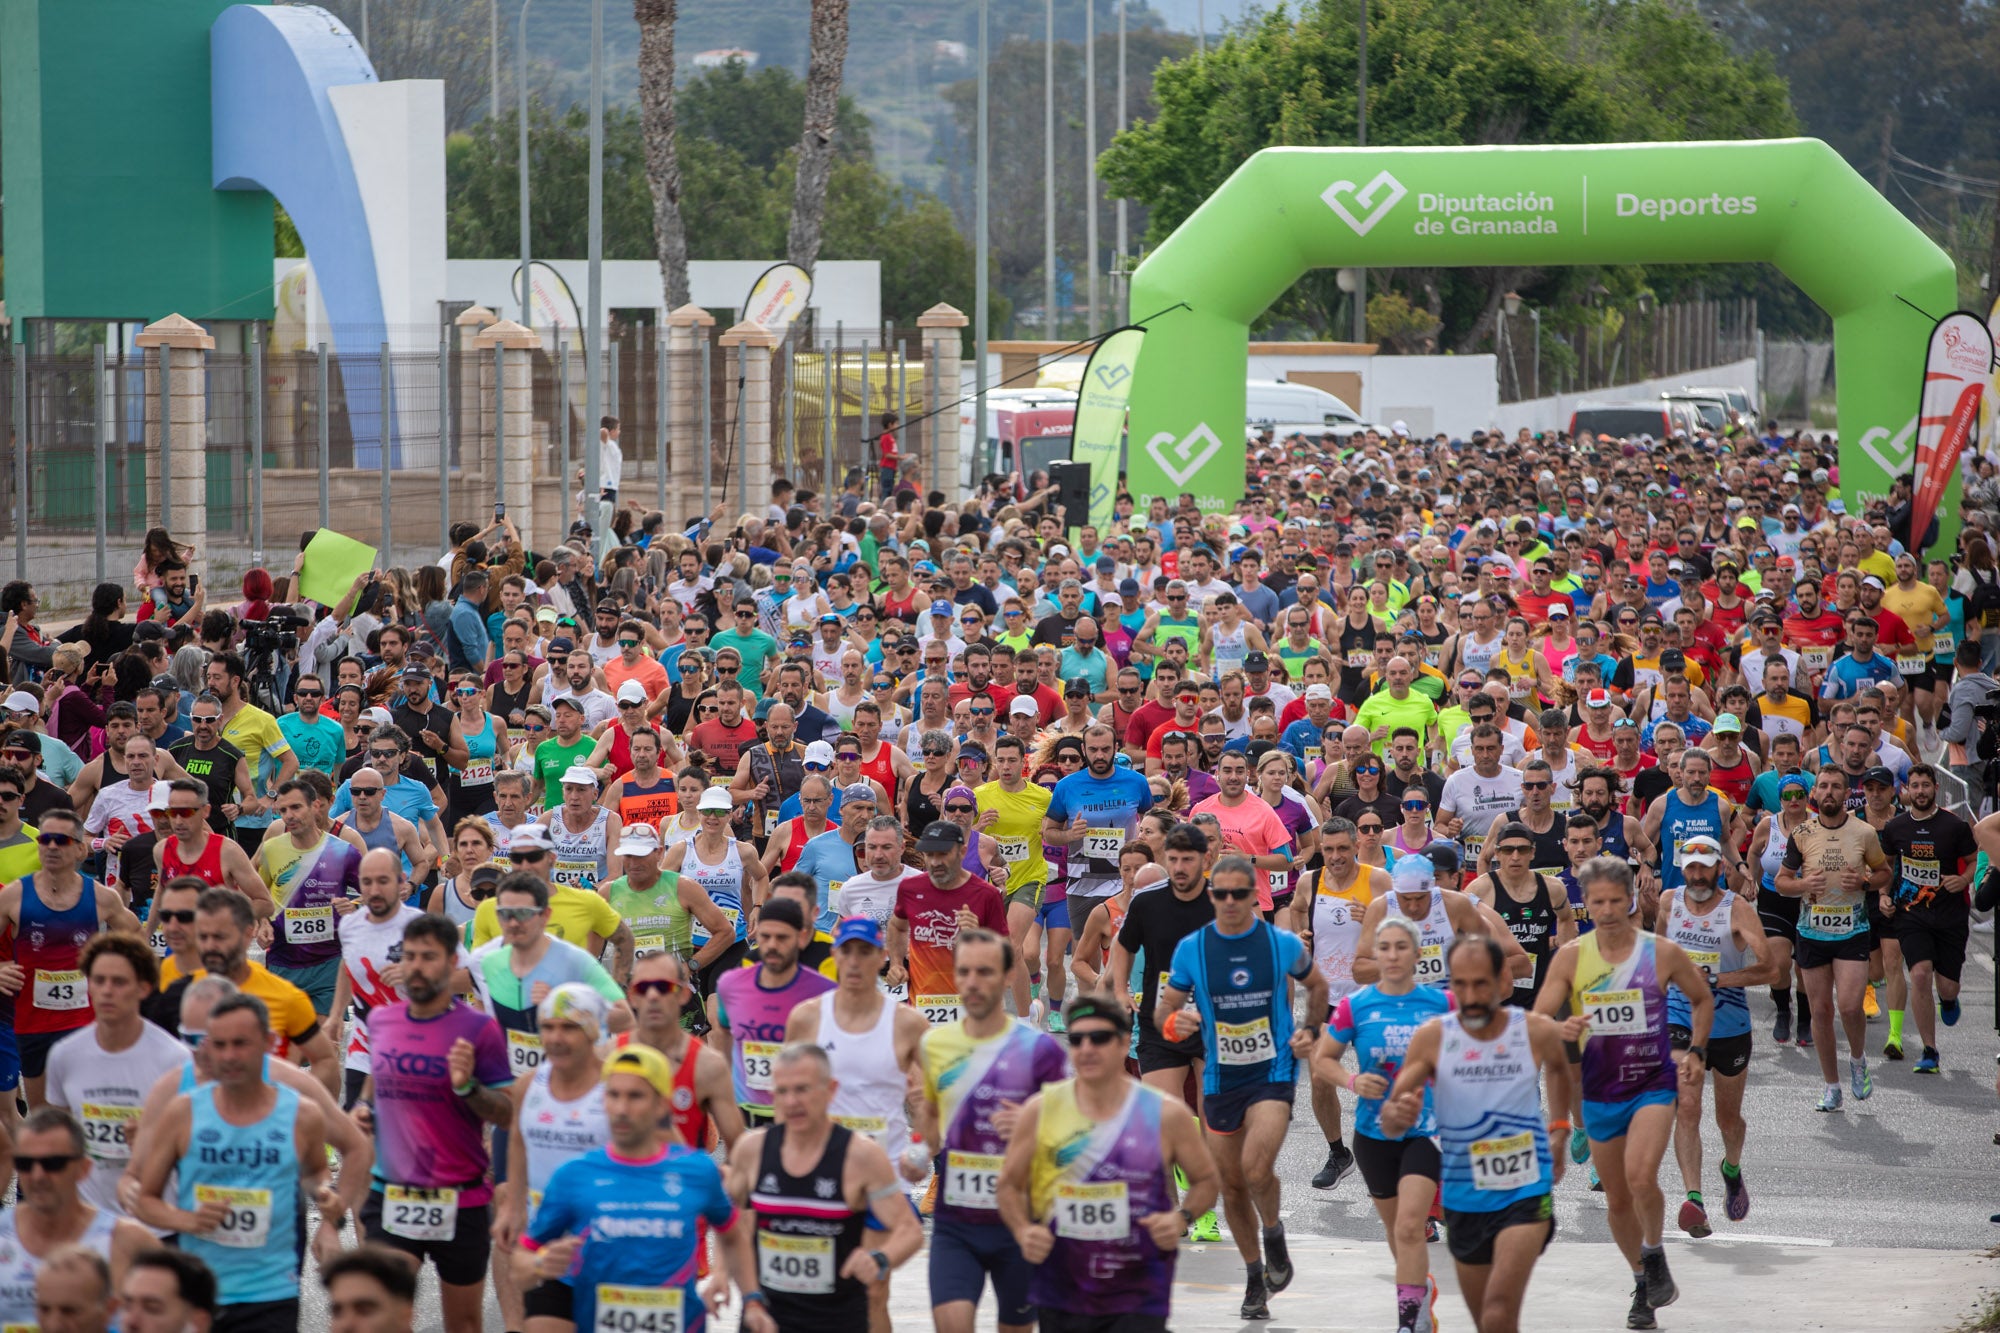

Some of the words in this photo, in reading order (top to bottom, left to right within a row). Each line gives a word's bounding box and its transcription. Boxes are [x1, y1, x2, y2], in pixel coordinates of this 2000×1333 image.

[1417, 190, 1556, 217] Diputación
[1615, 192, 1758, 221] Deportes
[1413, 216, 1445, 236] de
[1450, 213, 1559, 236] Granada
[1939, 392, 1978, 471] saborgranada.es
[1140, 494, 1224, 509] Diutción
[1809, 654, 1823, 664] 39
[1899, 661, 1924, 670] 3178
[186, 761, 213, 776] RUN
[461, 766, 492, 779] 2122
[1089, 838, 1118, 852] 732
[1910, 843, 1935, 851] FONDO
[1910, 849, 1935, 858] 2025
[1818, 859, 1848, 868] Maratón
[1903, 864, 1938, 880] 1026
[292, 918, 326, 934] 268
[1812, 914, 1852, 927] 1024
[1413, 958, 1443, 976] 30
[47, 985, 74, 1000] 43
[924, 1008, 959, 1023] 221
[1593, 1004, 1635, 1023] 109
[1219, 1032, 1272, 1055] 3093
[1453, 1063, 1523, 1078] MARACENA
[84, 1121, 128, 1144] 328
[198, 1144, 281, 1169] nerja
[1475, 1150, 1534, 1177] 1027
[956, 1173, 1000, 1195] 119
[395, 1205, 445, 1227] 228
[1067, 1203, 1116, 1225] 186
[769, 1254, 821, 1278] 408
[600, 1311, 677, 1332] 4045
